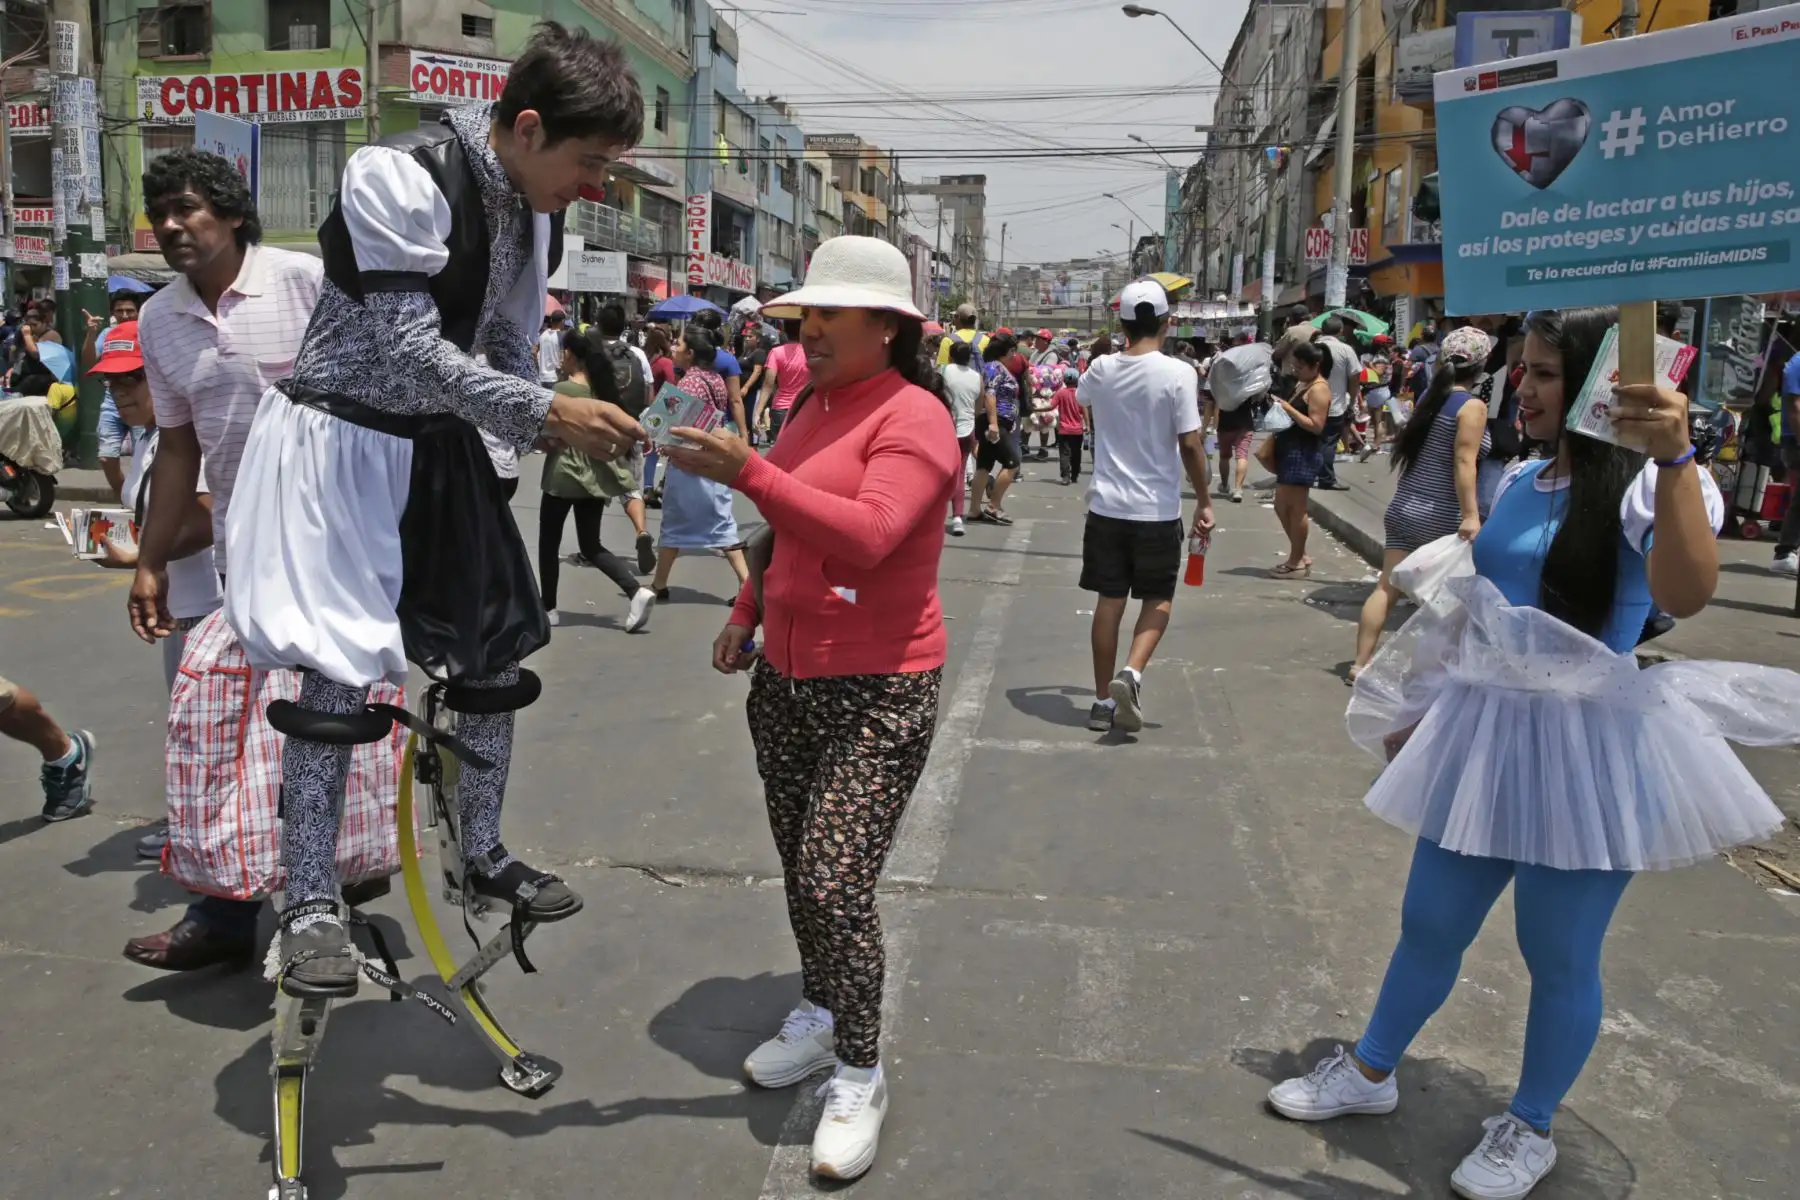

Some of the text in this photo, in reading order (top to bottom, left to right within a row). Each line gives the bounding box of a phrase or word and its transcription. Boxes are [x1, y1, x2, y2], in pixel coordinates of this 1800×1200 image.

[458, 60, 473, 69] 2do
[476, 62, 497, 72] PISO
[160, 68, 362, 116] CORTINAS
[268, 112, 297, 120] MUEBLES
[299, 111, 303, 119] Y
[306, 110, 328, 119] FORRO
[329, 109, 338, 118] DE
[340, 108, 362, 118] SILLAS
[1657, 98, 1736, 125] Amor
[1657, 117, 1788, 149] DeHierro
[1501, 178, 1795, 229] Dale de lactar a tus hijos,
[687, 194, 706, 285] CORTINAS
[1458, 236, 1491, 258] así
[1492, 235, 1522, 254] los
[1526, 226, 1626, 256] proteges
[1627, 224, 1645, 245] y
[1647, 213, 1732, 239] cuidas
[1734, 211, 1766, 229] su
[581, 253, 606, 265] Sydney
[1527, 246, 1768, 281] Te lo recuerda la #FamiliaMIDIS
